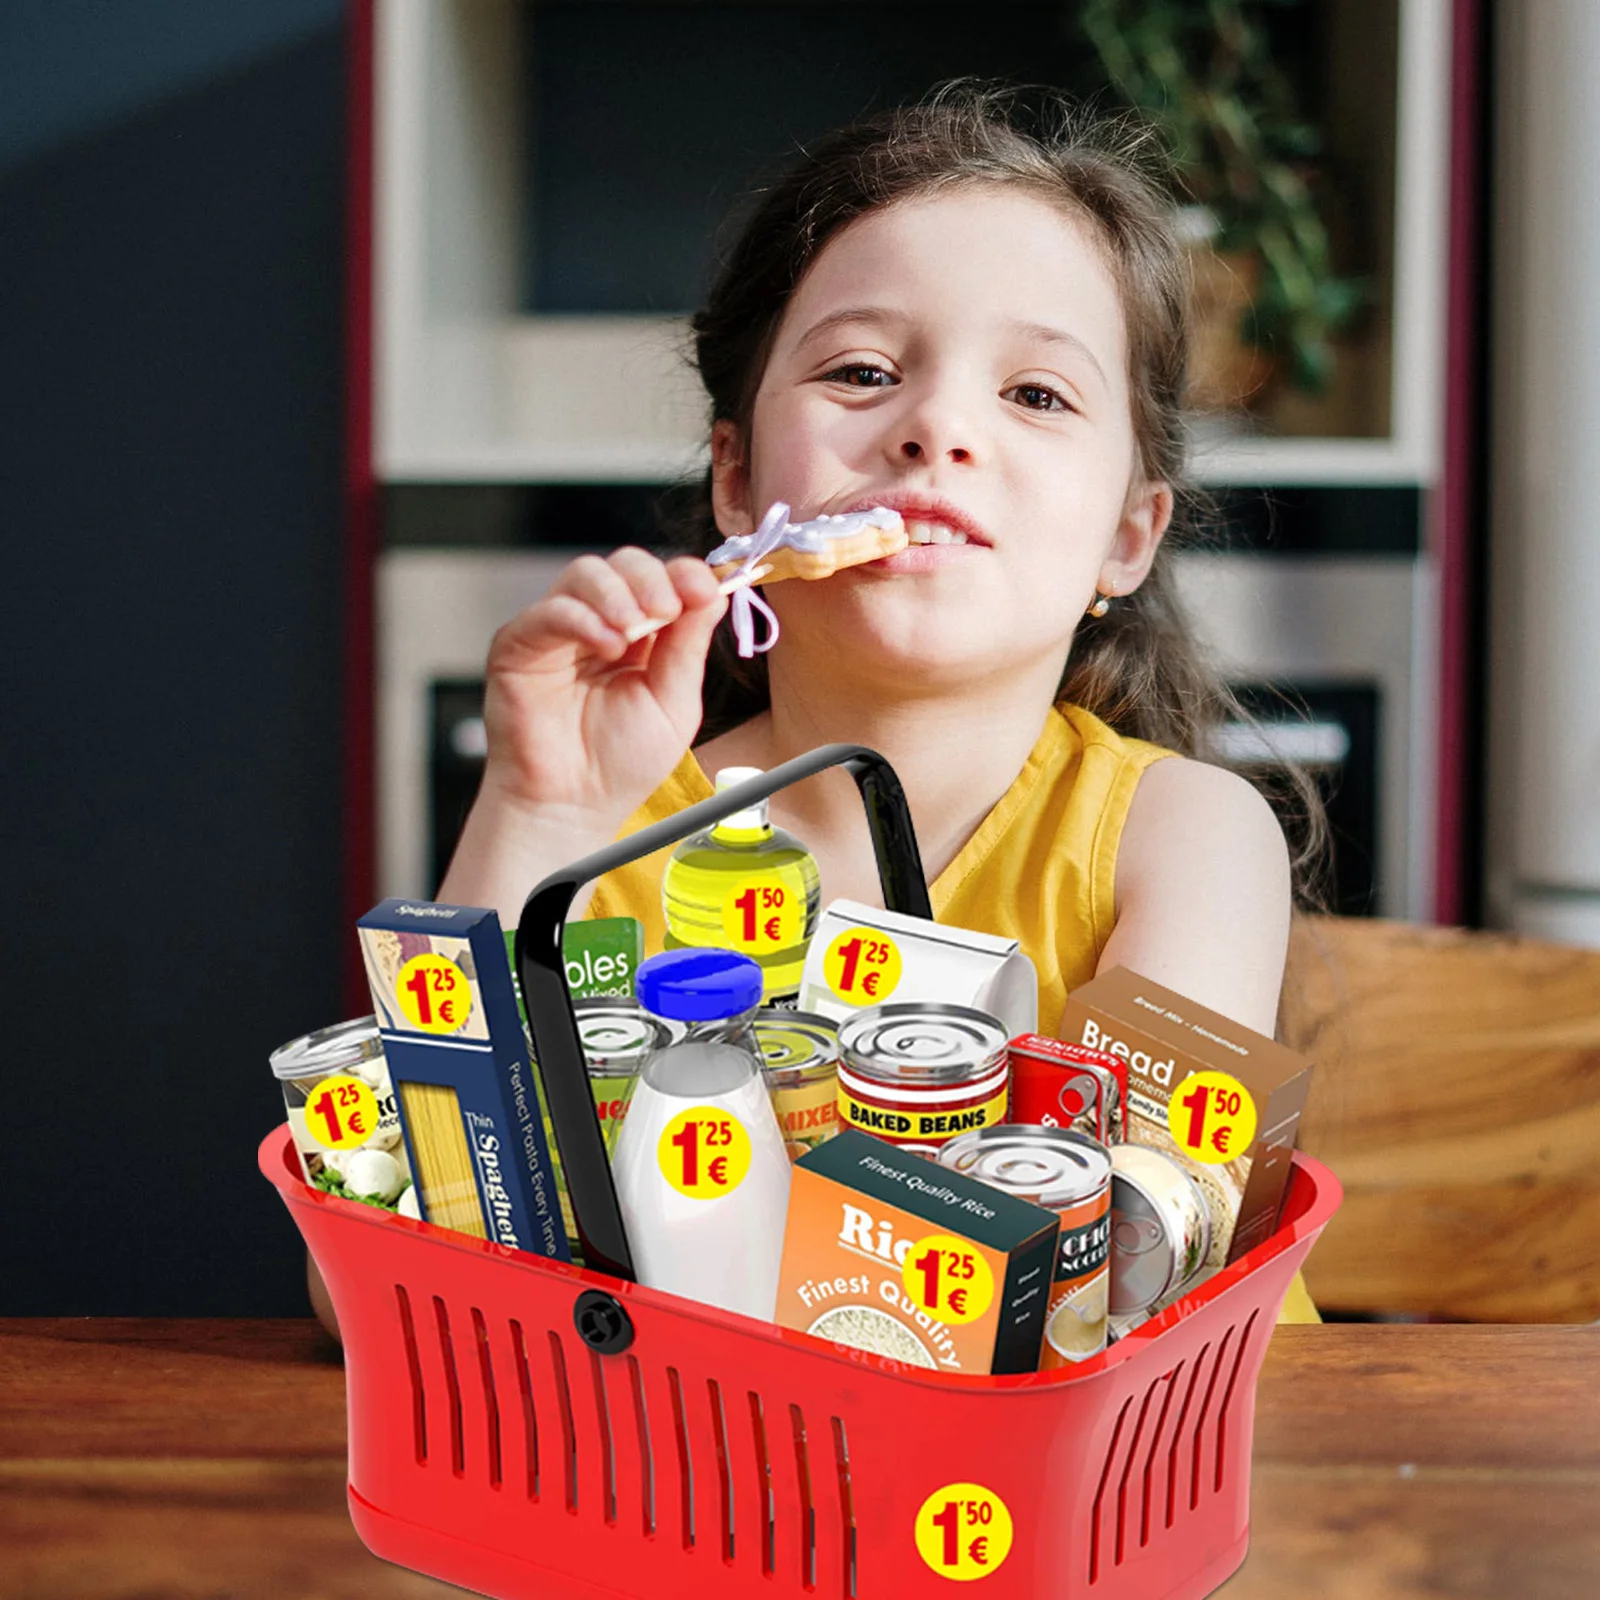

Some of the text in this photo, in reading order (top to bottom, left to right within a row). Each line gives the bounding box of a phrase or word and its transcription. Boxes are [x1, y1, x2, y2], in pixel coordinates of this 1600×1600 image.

[1081, 1018, 1175, 1087] Bread
[850, 1102, 986, 1134] BAKED BEANS
[859, 1156, 996, 1220] Finest Quality Rice
[838, 1203, 914, 1265] Ric
[797, 1275, 870, 1309] Finest
[879, 1279, 961, 1369] Quality
